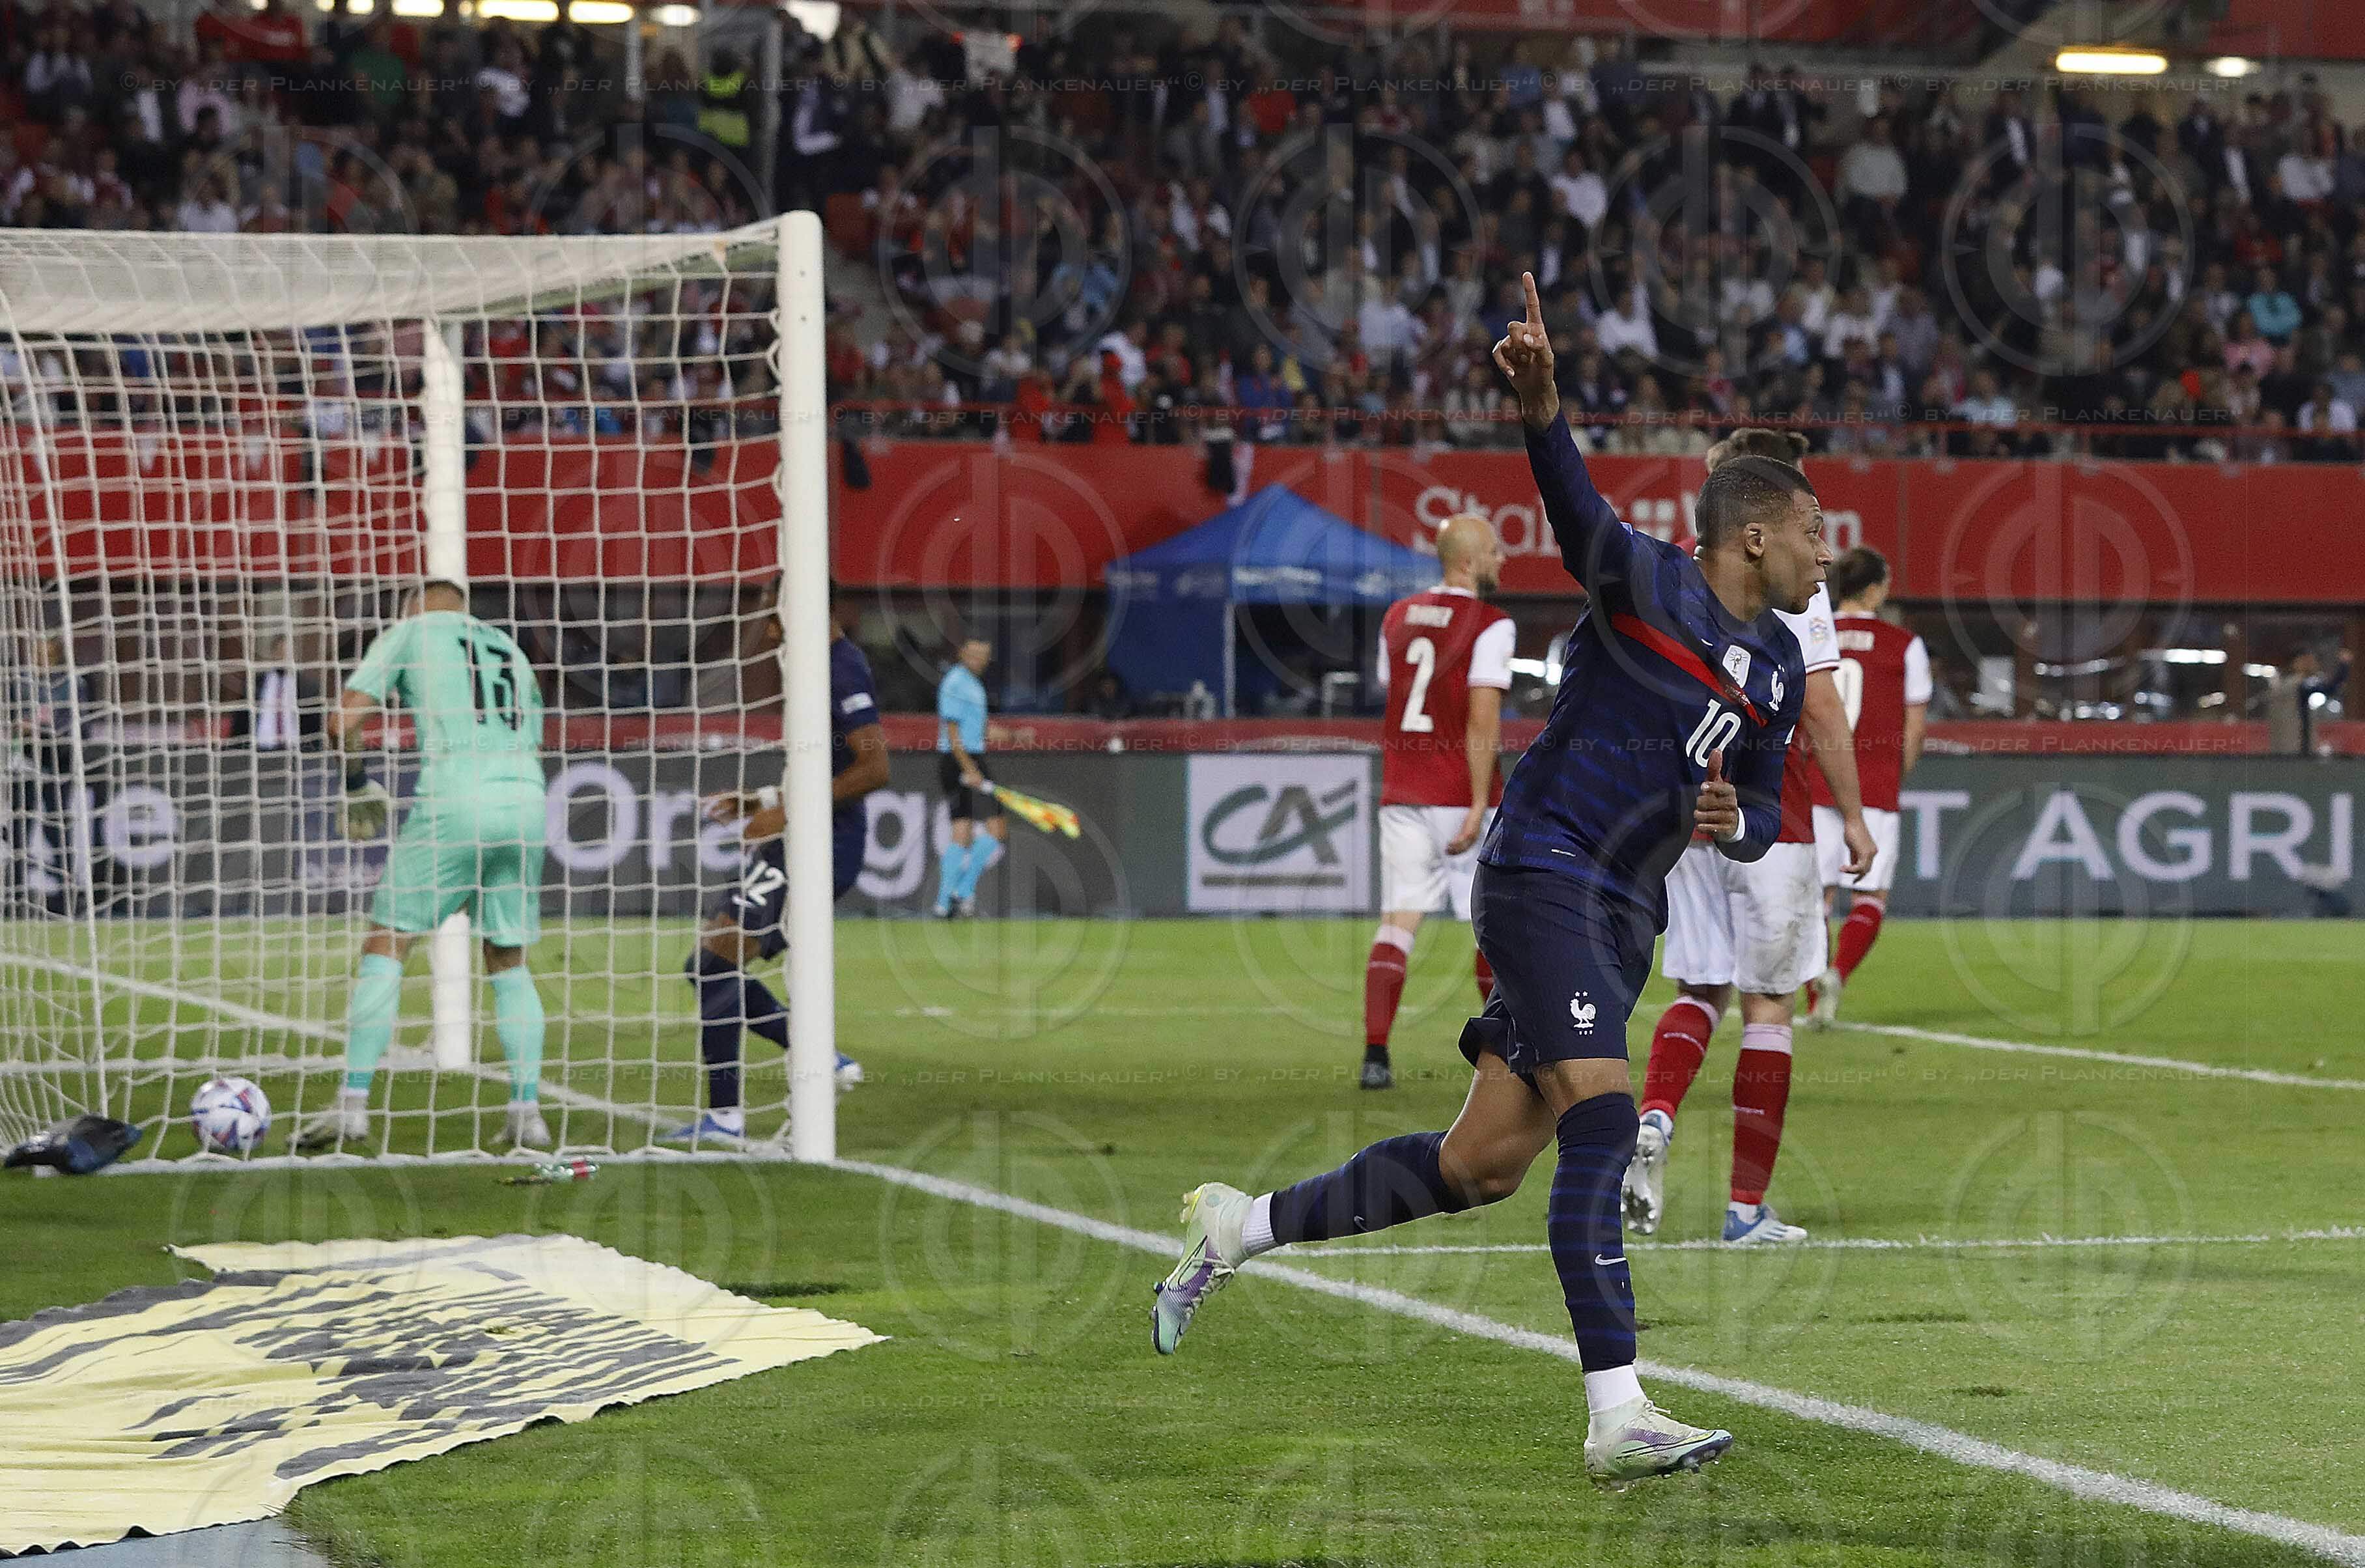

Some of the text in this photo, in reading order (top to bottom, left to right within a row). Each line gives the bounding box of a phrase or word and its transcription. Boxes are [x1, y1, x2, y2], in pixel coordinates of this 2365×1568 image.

[458, 636, 524, 731] 13
[1401, 636, 1436, 733] 2
[1685, 699, 1741, 768] 10
[2011, 790, 2353, 881] AGRI
[744, 860, 785, 906] 12
